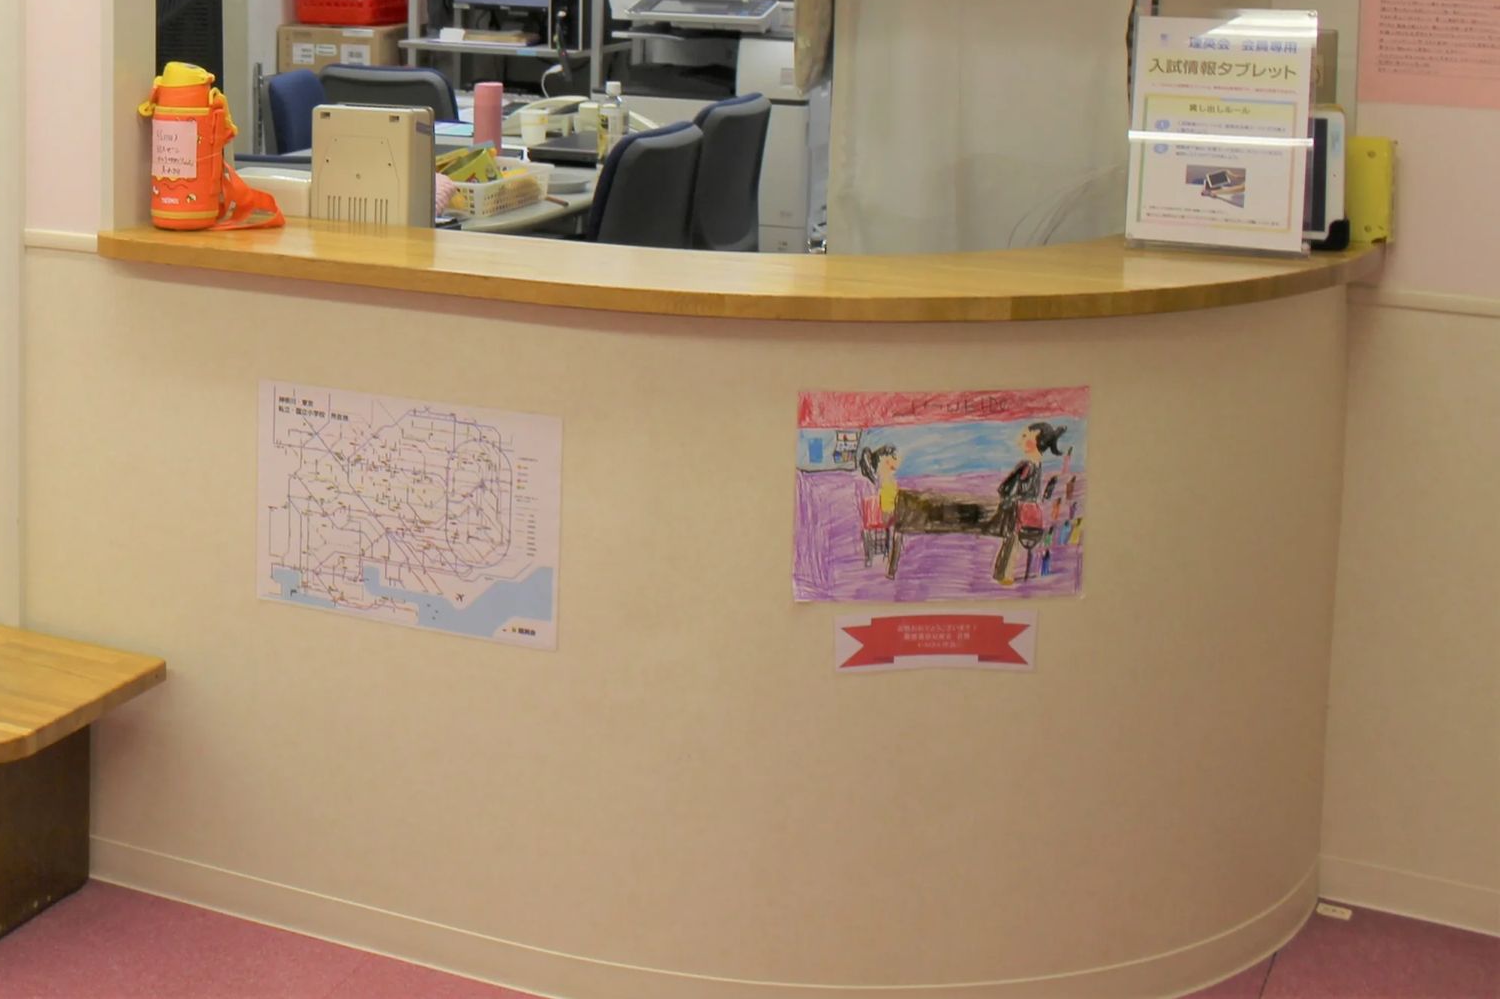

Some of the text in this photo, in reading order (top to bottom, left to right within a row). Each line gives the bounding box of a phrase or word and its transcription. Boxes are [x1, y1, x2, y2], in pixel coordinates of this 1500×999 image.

[1242, 38, 1298, 55] 会員専用
[1149, 58, 1297, 81] 入試情報タブレット
[1189, 102, 1251, 116] 貸し出しルール
